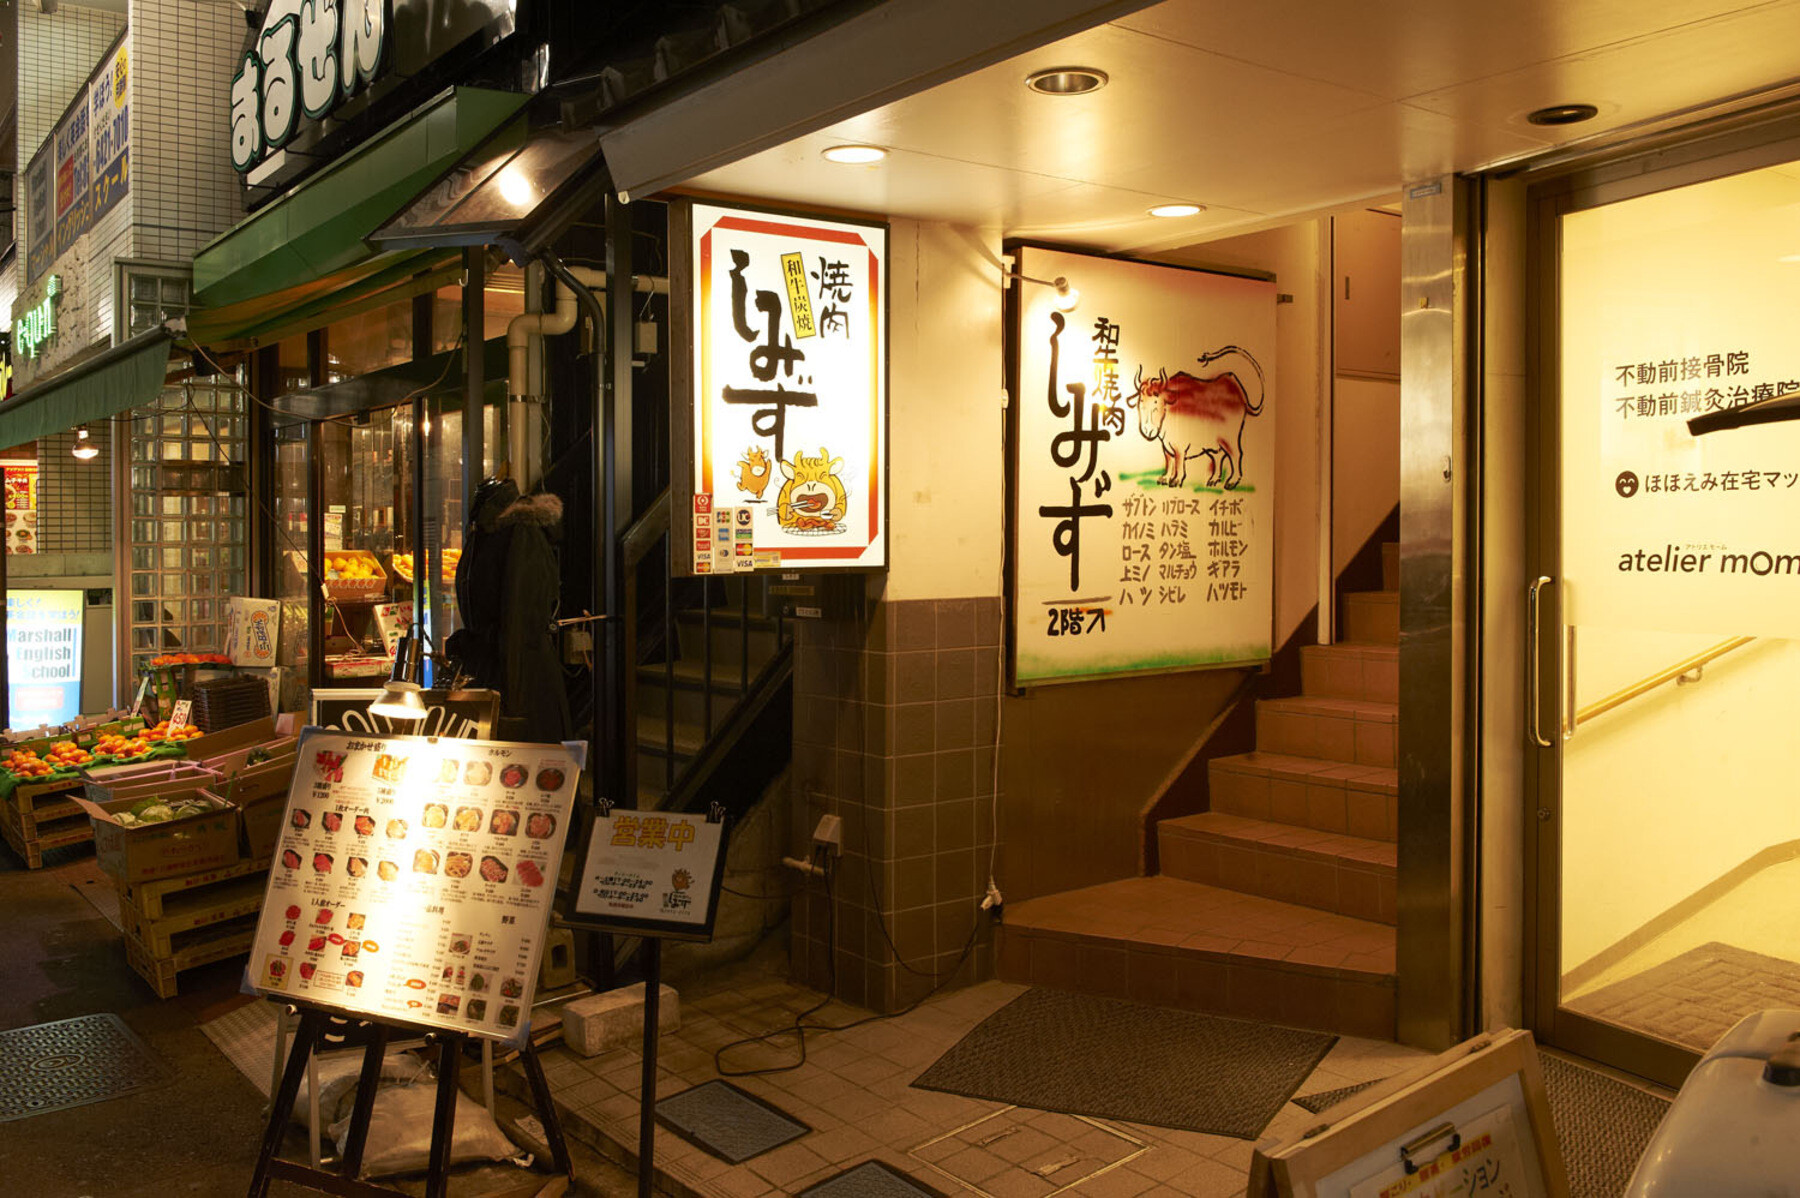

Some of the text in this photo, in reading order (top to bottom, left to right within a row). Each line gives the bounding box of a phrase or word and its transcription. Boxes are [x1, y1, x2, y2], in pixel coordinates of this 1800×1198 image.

[230, 0, 385, 173] まるぜん
[786, 260, 813, 332] 和牛炭焼
[811, 256, 853, 339] 焼肉
[722, 248, 818, 463] しみず
[1615, 350, 1749, 387] 不動前接骨院
[1038, 311, 1113, 592] しみず
[1122, 493, 1244, 518] ザブトン リブロース イチボ
[1122, 521, 1156, 540] カイノミ
[1161, 520, 1188, 538] ハラミ
[737, 559, 753, 568] VISA
[1122, 540, 1248, 562] ロース タン塩 ホルモン
[1618, 545, 1711, 573] atelier
[1158, 563, 1198, 581] マルチョウ
[1207, 560, 1240, 579] ギアラ
[1158, 584, 1187, 604] シビレ
[1206, 581, 1248, 603] ハツモト
[1046, 608, 1084, 637] 2階
[16, 645, 71, 662] English
[488, 748, 512, 757] ホルモン
[610, 814, 696, 852] 営業中
